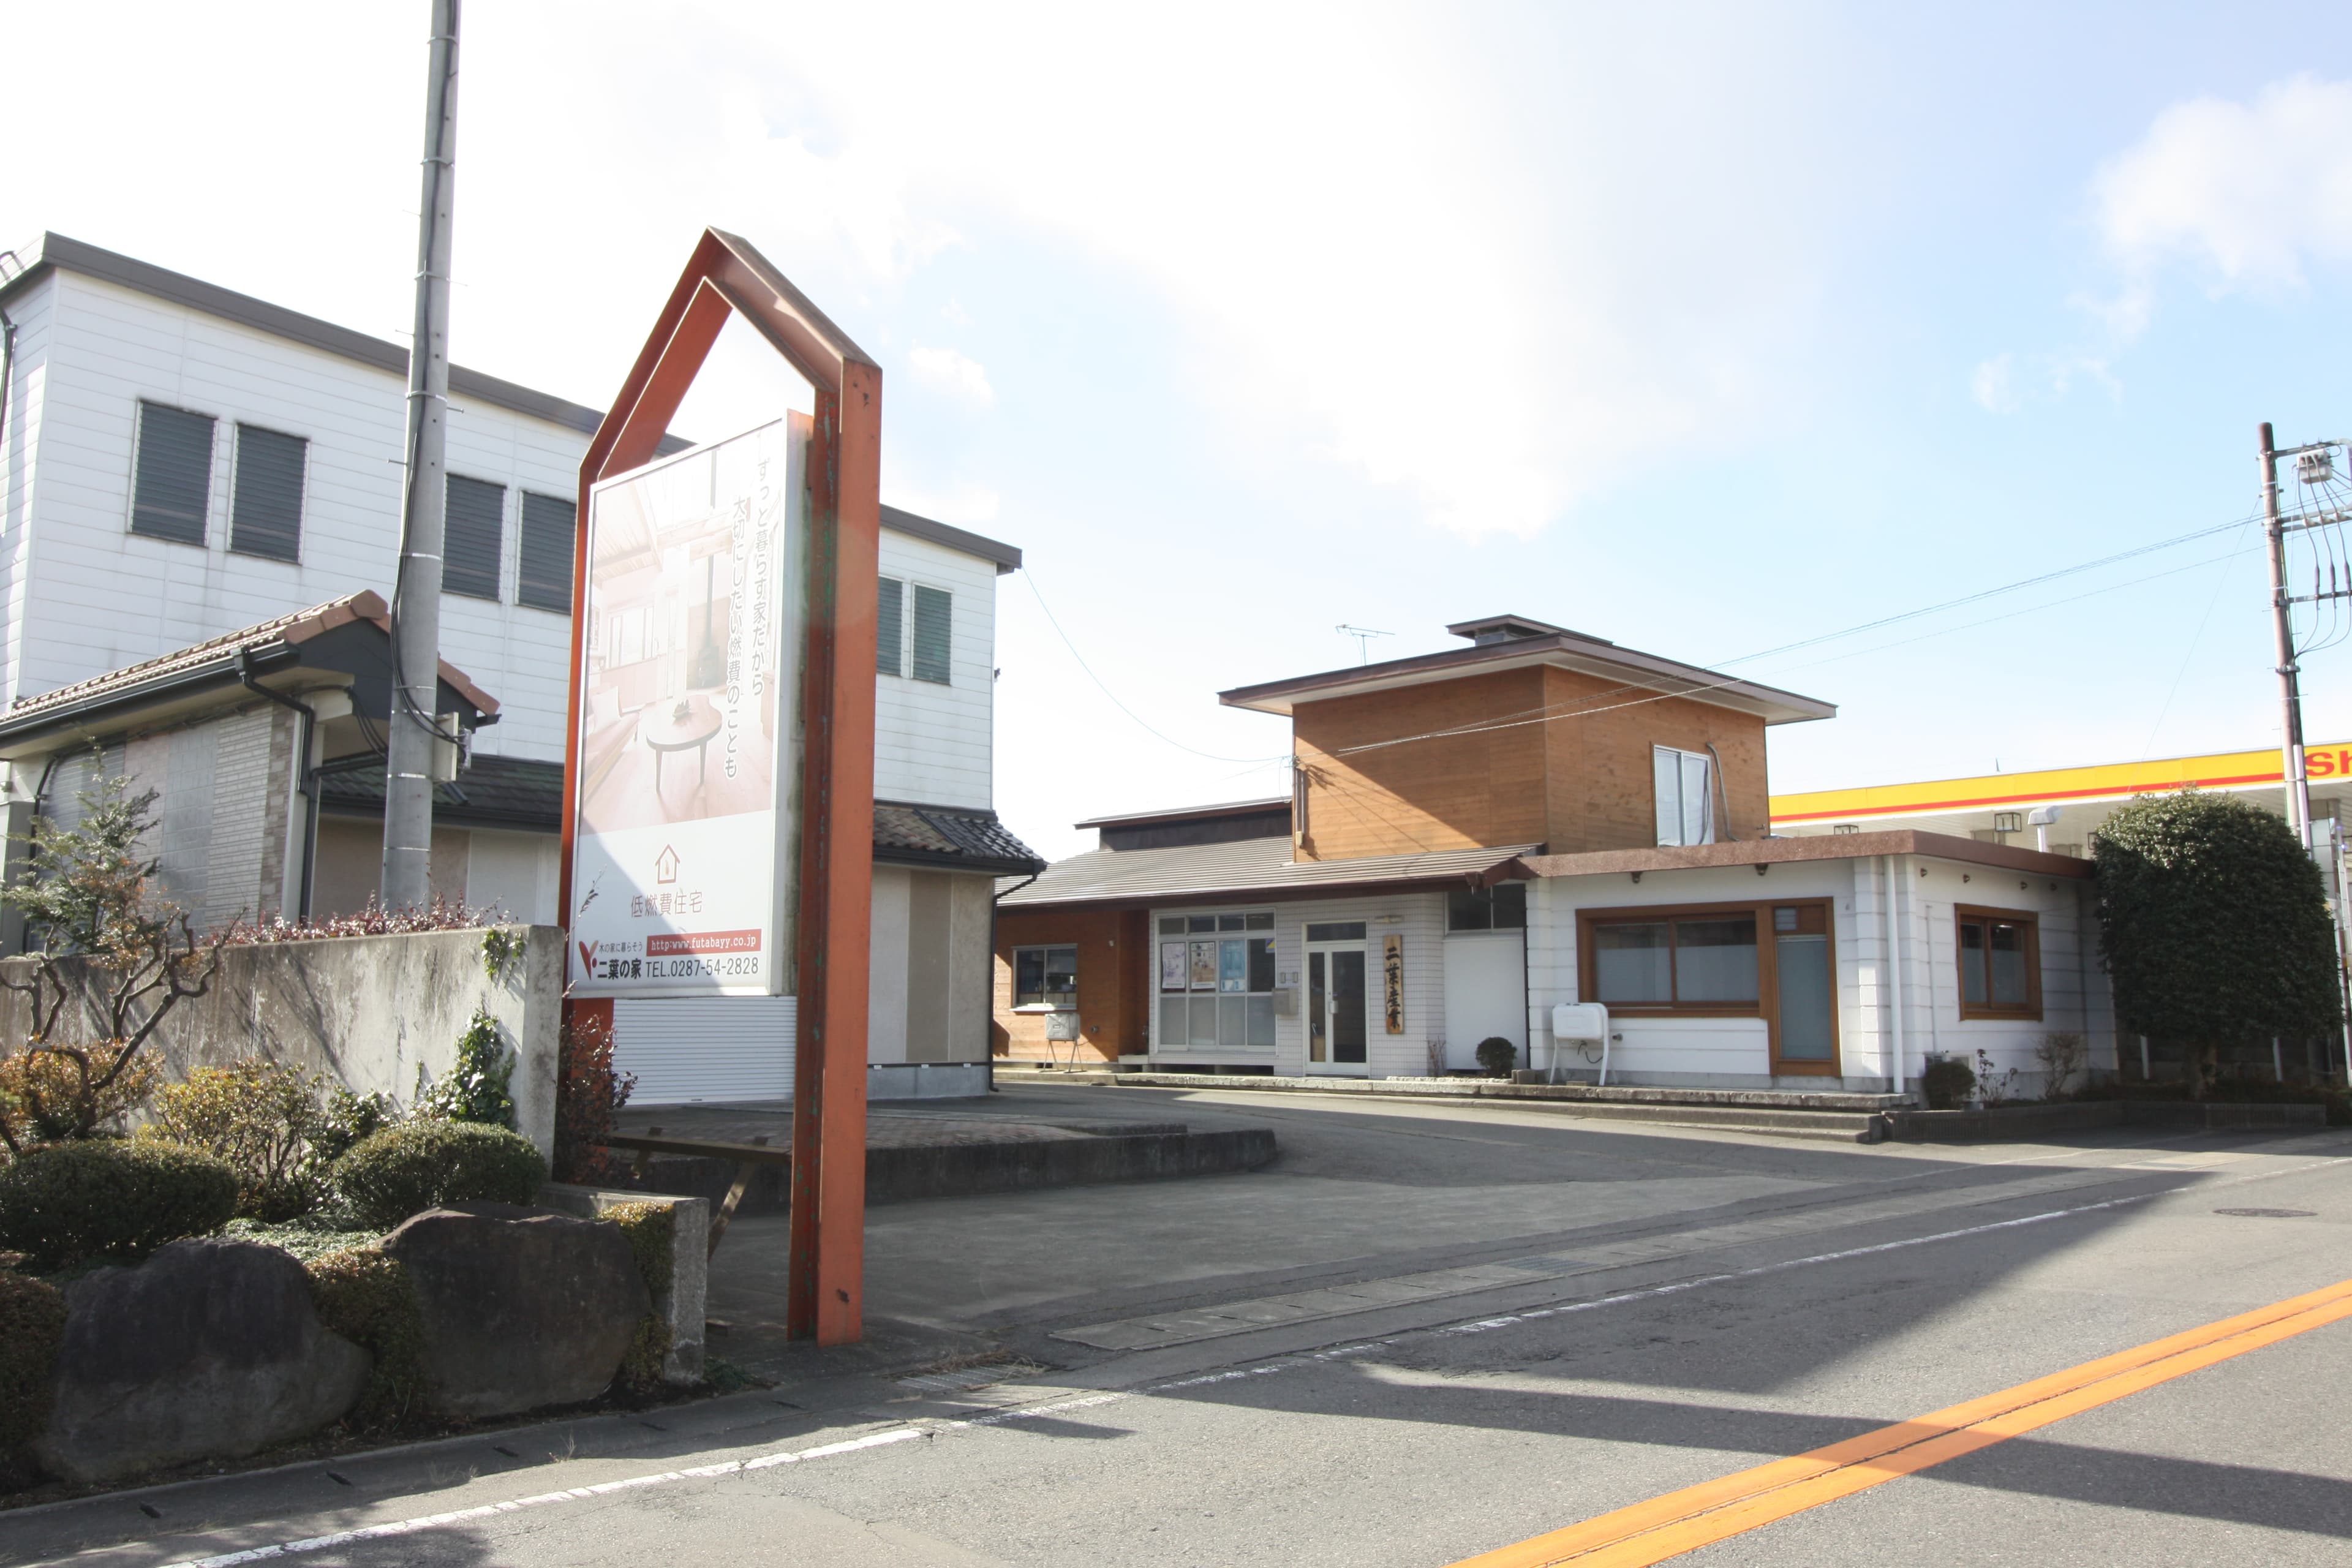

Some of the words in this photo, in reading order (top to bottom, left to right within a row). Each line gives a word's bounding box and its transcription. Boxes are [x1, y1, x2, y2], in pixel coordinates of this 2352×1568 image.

[751, 457, 771, 696] ずっと暮らす家だから
[725, 495, 746, 778] 大切にしたい燃費のことも
[631, 888, 703, 918] 低燃費住宅
[598, 958, 642, 980] 二葉の家
[646, 957, 758, 978] TEL.0287-54-2828
[599, 941, 643, 954] 木の家に暮らそう
[1385, 946, 1401, 1030] 二葉産業
